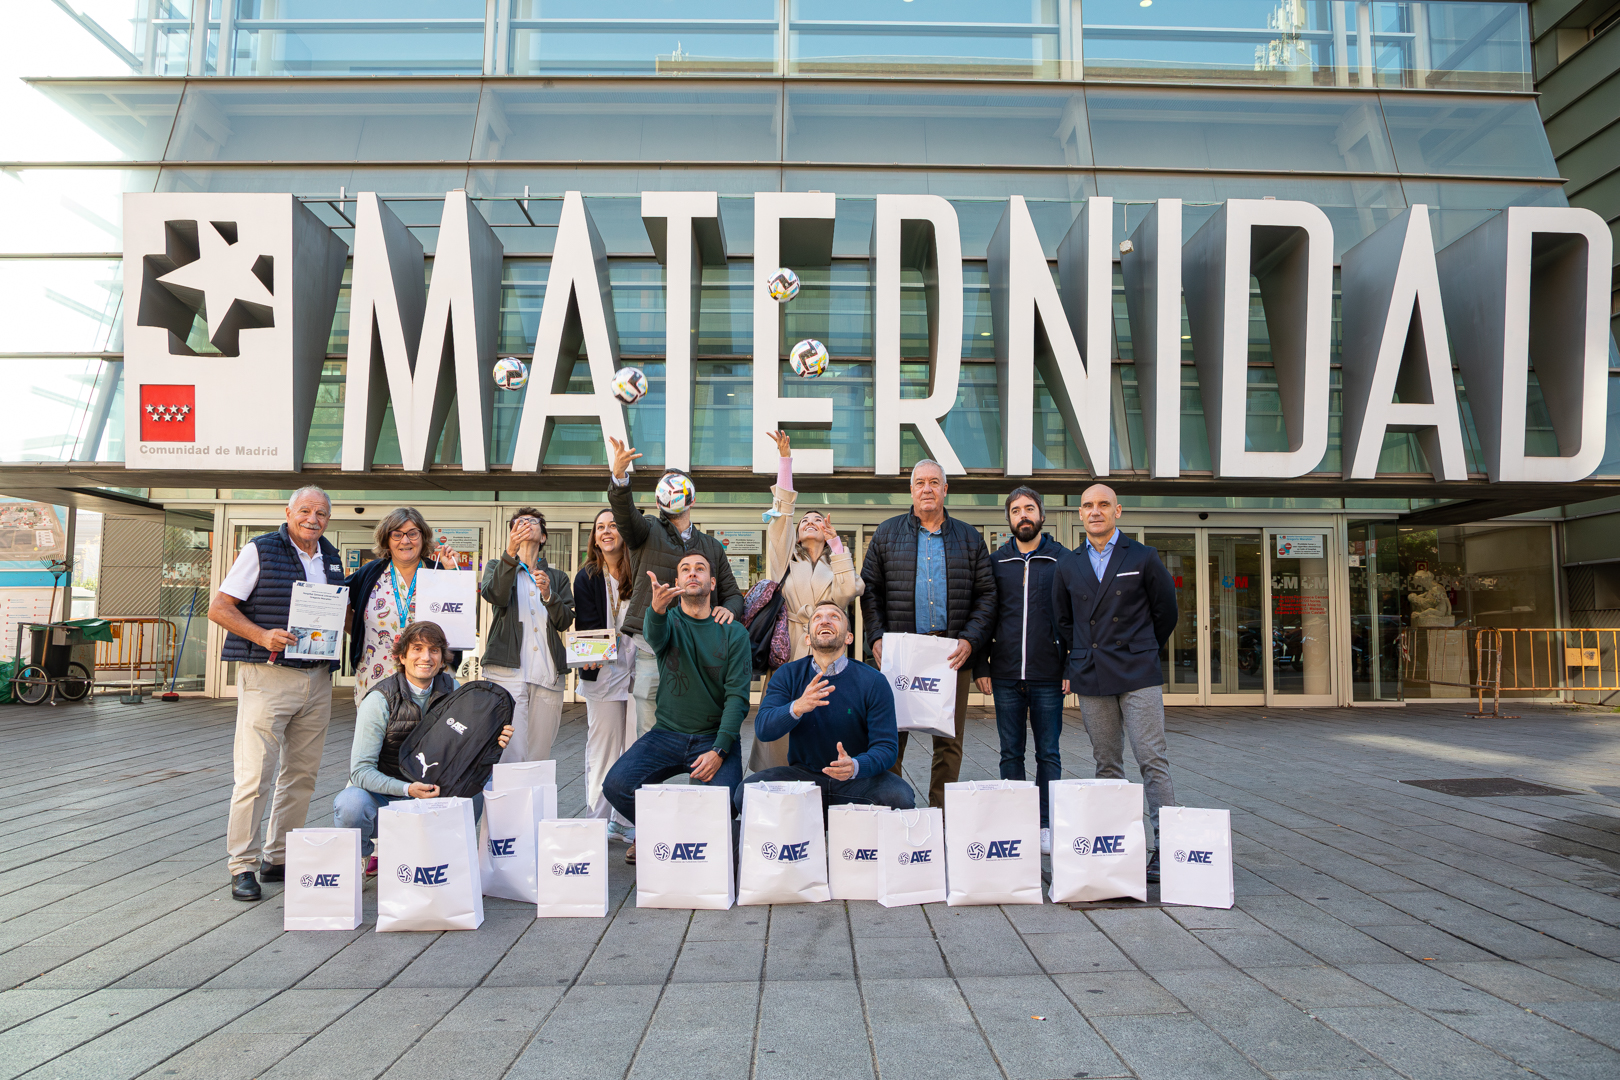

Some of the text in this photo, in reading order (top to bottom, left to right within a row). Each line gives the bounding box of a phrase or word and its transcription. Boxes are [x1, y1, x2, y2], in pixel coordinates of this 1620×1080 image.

[341, 190, 1612, 484] MATERNIDAD
[140, 445, 278, 456] Comunidad de Madrid
[1235, 576, 1248, 588] M
[1283, 576, 1298, 589] M
[441, 602, 463, 613] AFE
[910, 676, 941, 692] AFE
[450, 721, 468, 734] AFE
[778, 841, 810, 861] AFE
[986, 840, 1022, 859] AFE
[1091, 835, 1125, 854] AFE
[670, 843, 708, 861] AFE
[855, 849, 878, 861] AFE
[910, 849, 932, 863] AFE
[1187, 850, 1213, 864] AFE
[413, 864, 449, 885] AFE
[565, 863, 590, 875] AFE
[313, 874, 340, 887] AFE
